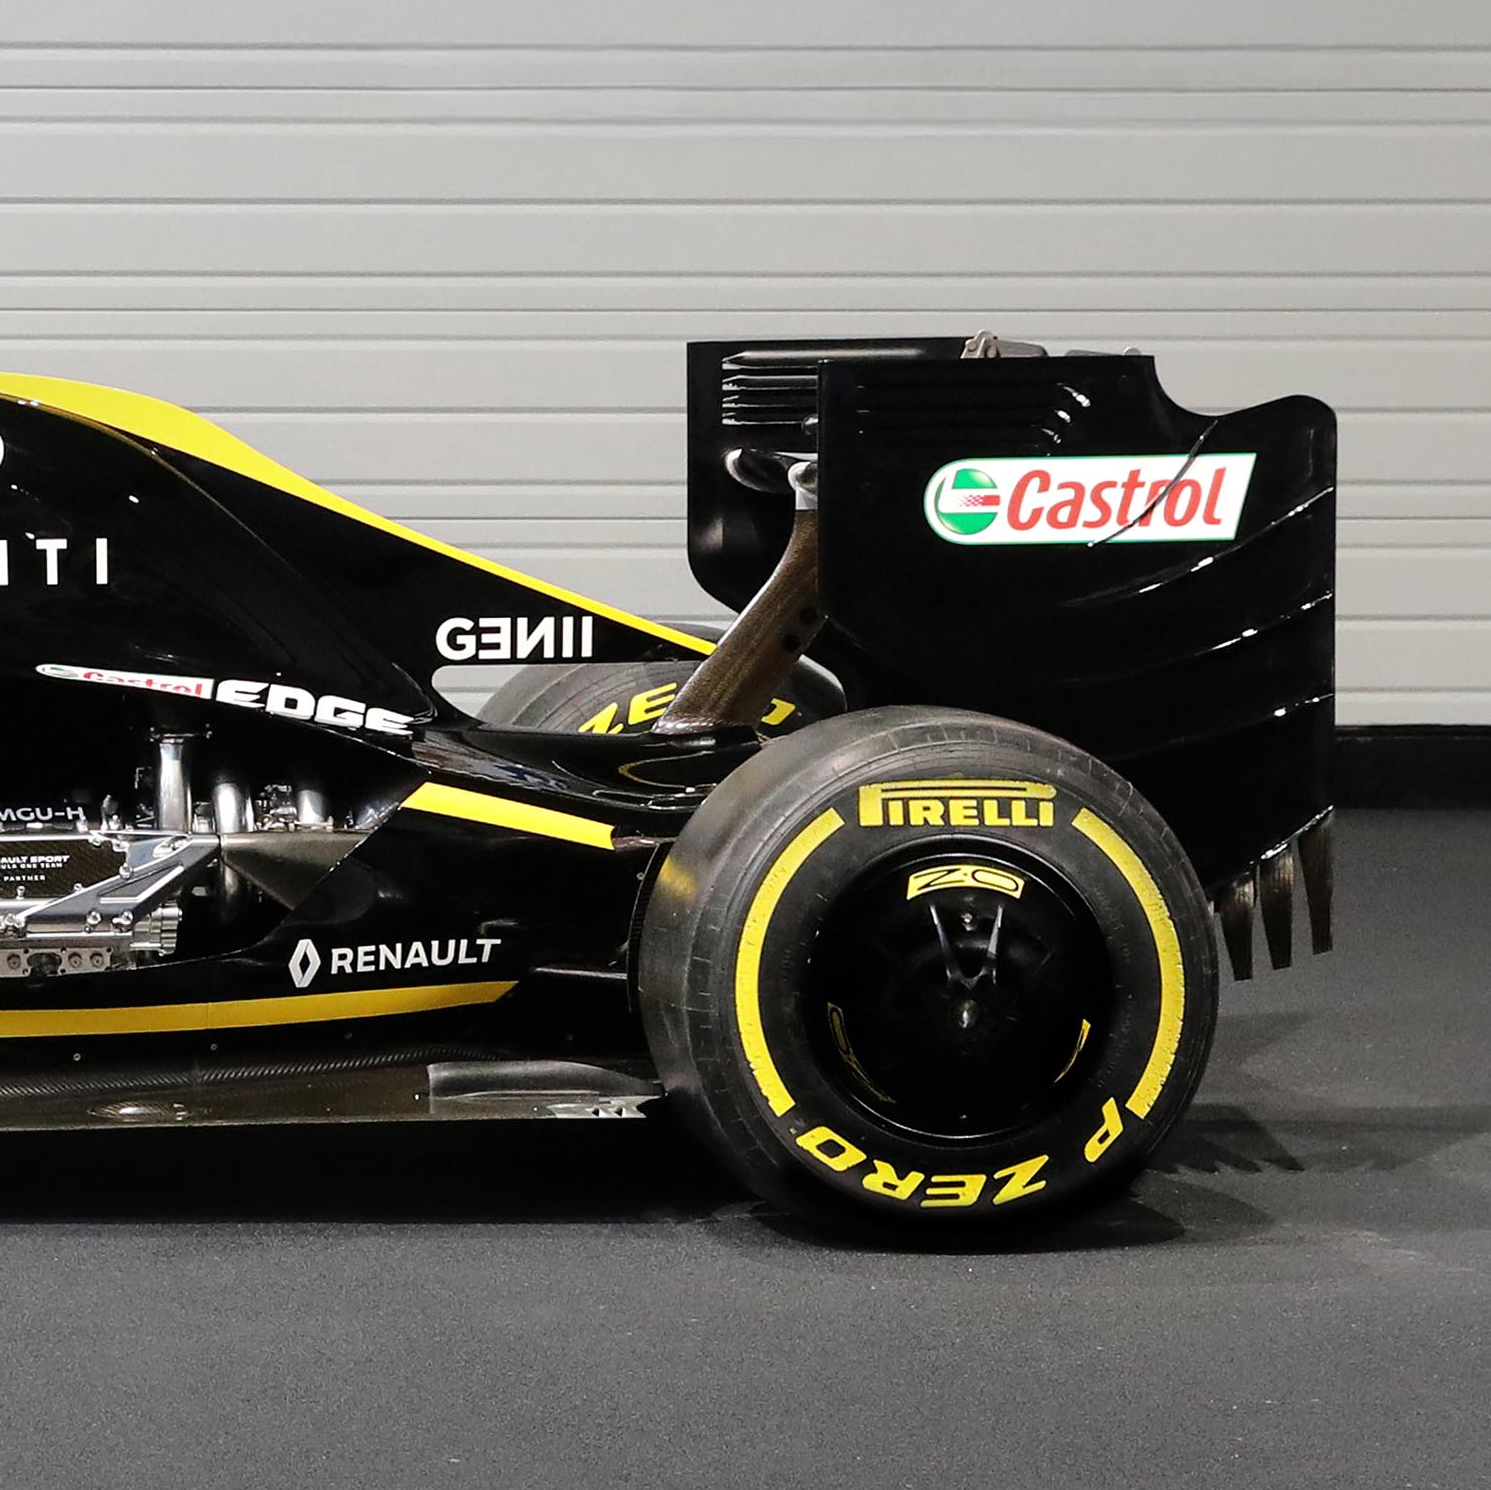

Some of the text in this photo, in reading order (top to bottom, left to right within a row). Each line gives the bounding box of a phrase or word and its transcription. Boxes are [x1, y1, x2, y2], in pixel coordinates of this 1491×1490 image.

[1007, 467, 1226, 531] Castrol
[216, 678, 414, 737] EDGE
[858, 779, 1057, 827] PIRELLI
[3, 874, 46, 883] PARTNER
[29, 854, 70, 864] SPORT
[330, 938, 502, 975] RENAULT
[795, 1097, 1124, 1207] P ZERO
